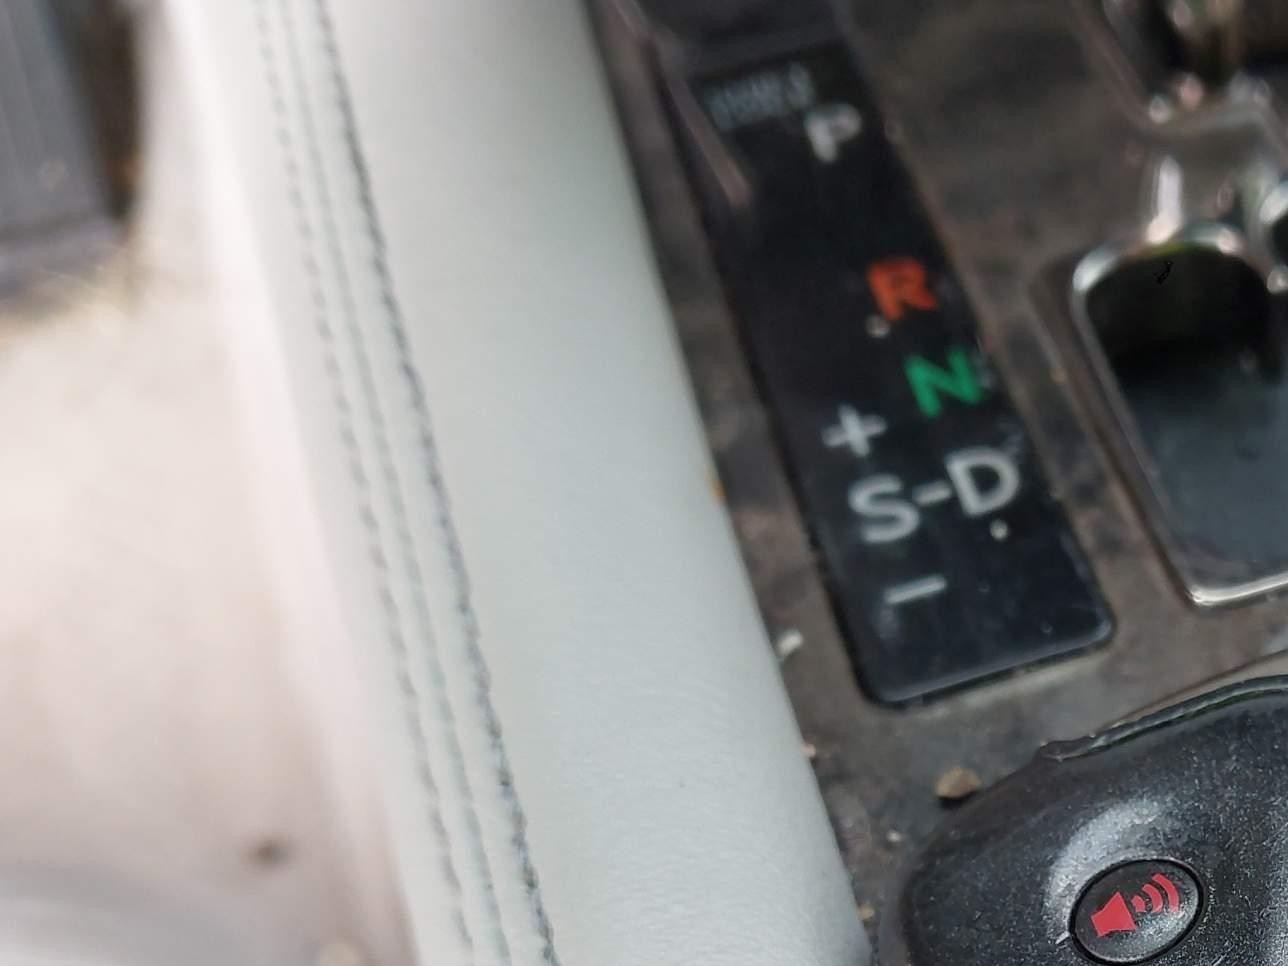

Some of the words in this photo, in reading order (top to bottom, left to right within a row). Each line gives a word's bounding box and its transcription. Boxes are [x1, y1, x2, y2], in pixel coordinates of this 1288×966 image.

[807, 104, 861, 162] P
[867, 258, 937, 320] R
[904, 349, 983, 416] N
